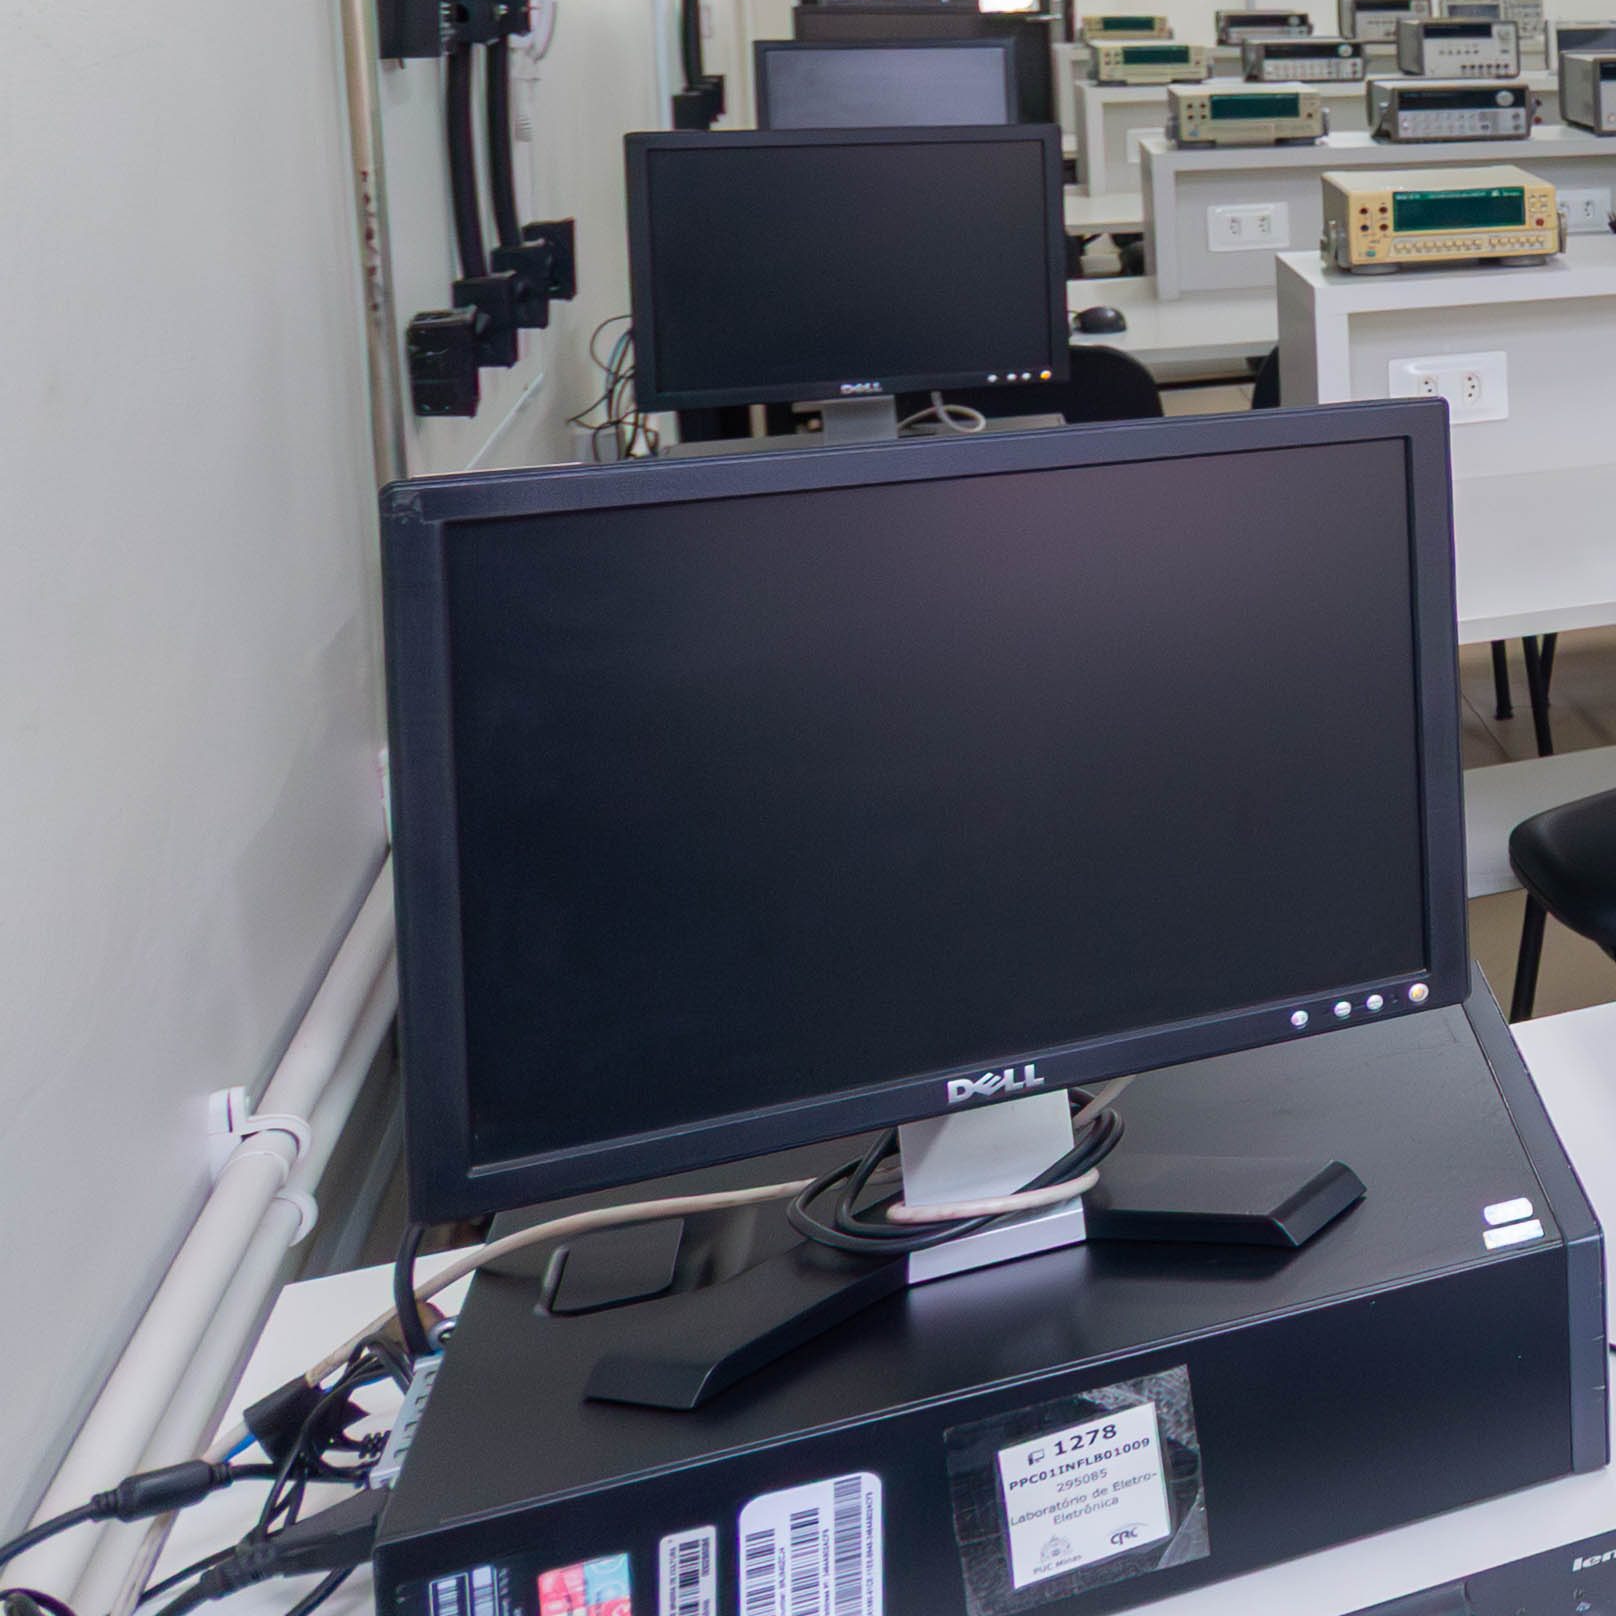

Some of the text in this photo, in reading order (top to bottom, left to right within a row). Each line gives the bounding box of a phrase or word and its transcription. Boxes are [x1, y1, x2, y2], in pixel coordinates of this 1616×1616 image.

[840, 381, 883, 394] DELL
[947, 1064, 1045, 1104] DELL
[1054, 1424, 1118, 1457] 1278
[1008, 1437, 1151, 1491] PPC01INFLB01009
[1056, 1468, 1108, 1493] 295085
[1010, 1471, 1158, 1526] Laboratório de Eletro-
[1053, 1495, 1119, 1525] Eletrônica
[1033, 1560, 1053, 1575] PUC
